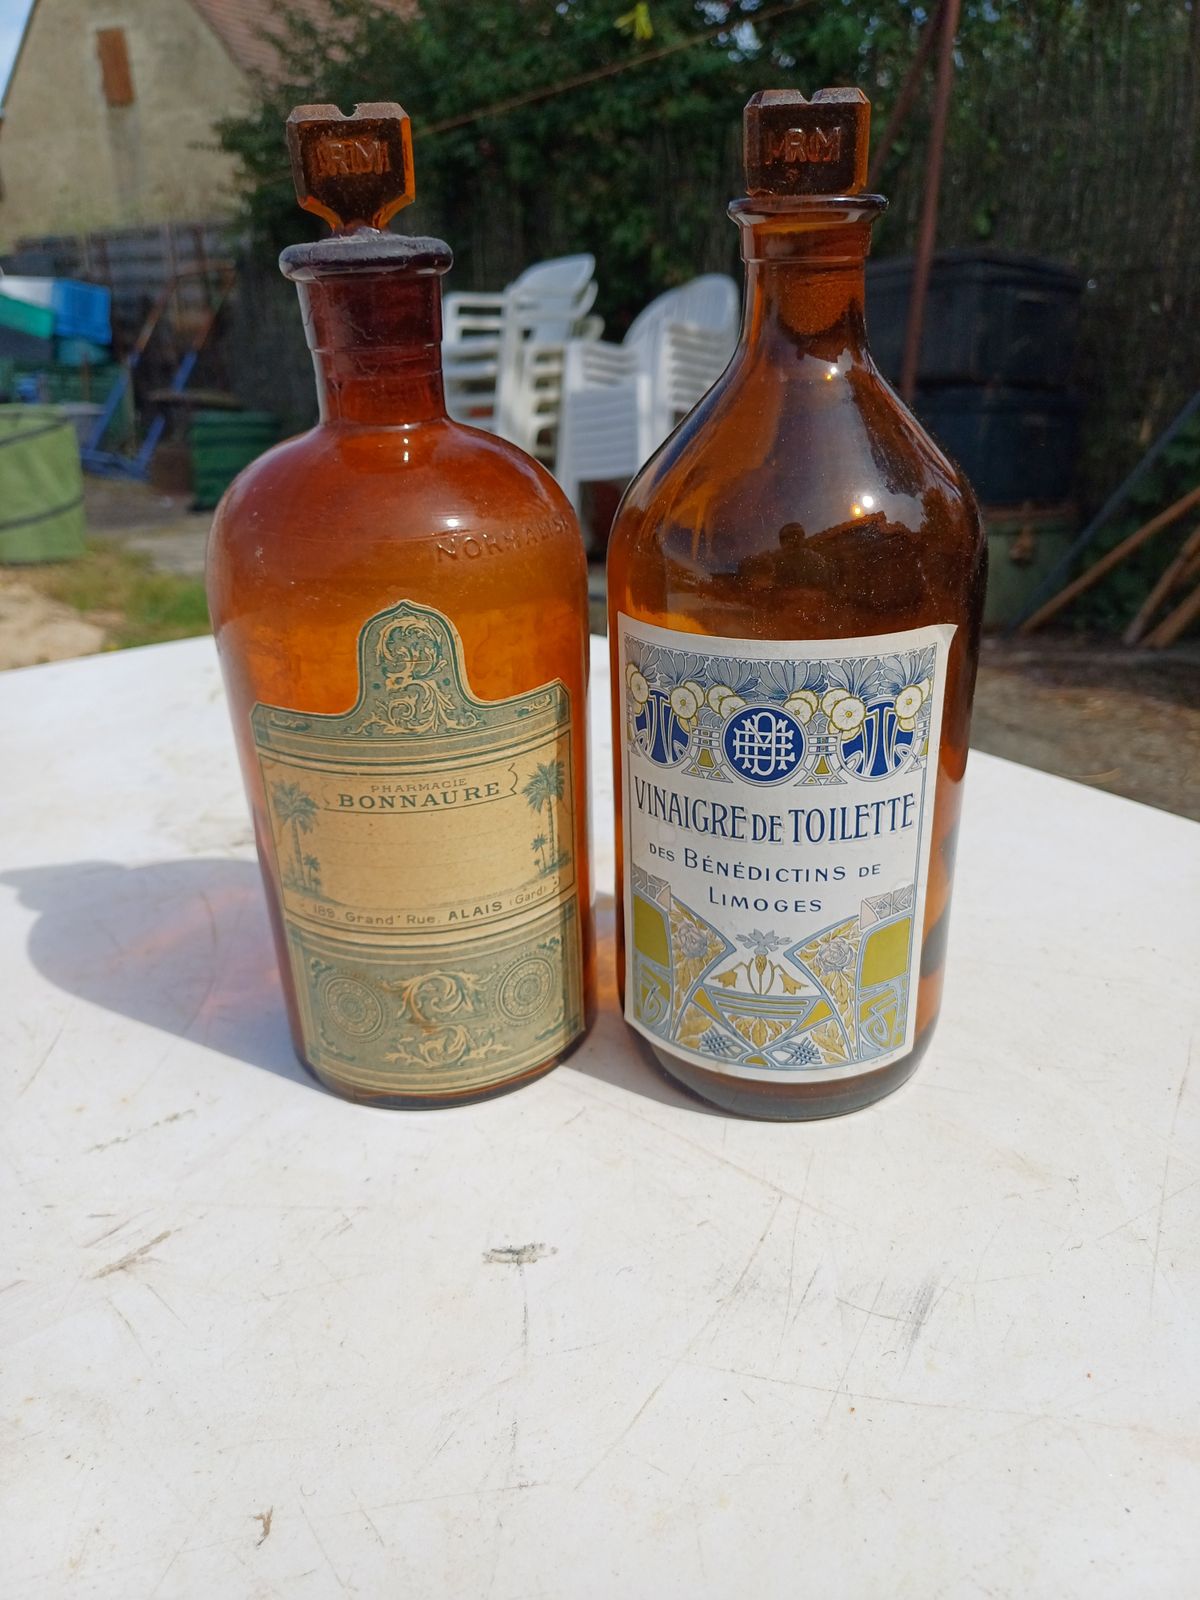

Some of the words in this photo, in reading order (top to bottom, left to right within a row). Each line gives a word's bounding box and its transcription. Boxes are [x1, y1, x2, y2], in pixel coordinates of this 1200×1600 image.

[337, 782, 500, 809] BONNAURE
[371, 778, 467, 793] PHARMACIE
[633, 776, 747, 840] VINAIGRE
[751, 814, 782, 843] DE
[788, 793, 916, 843] TOILETTE
[649, 842, 675, 862] DES
[684, 848, 847, 882] BÉNÉDICTINS
[858, 864, 882, 878] DE
[448, 901, 503, 921] ALAIS
[709, 886, 823, 913] LIMOGES
